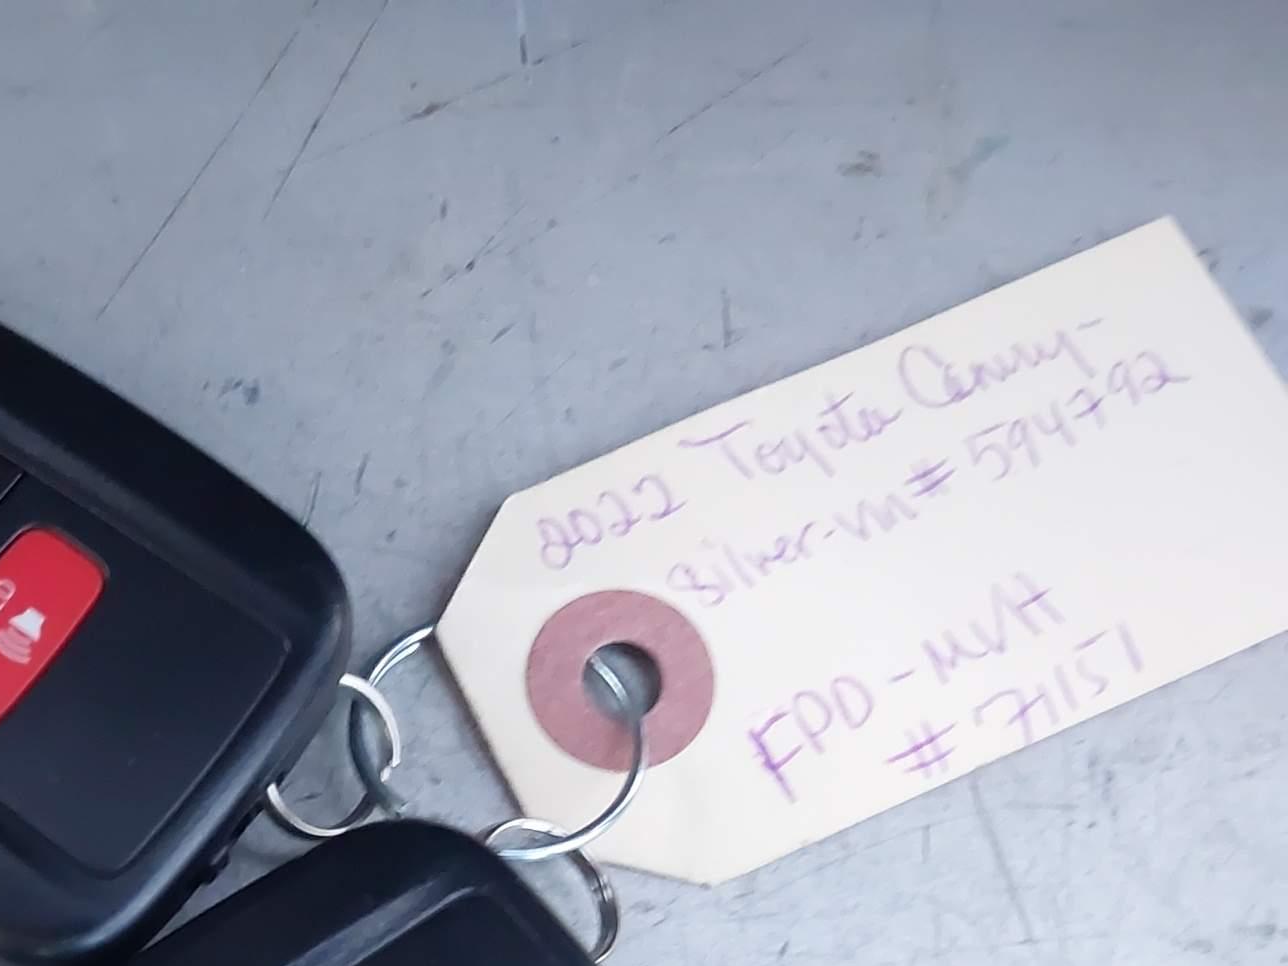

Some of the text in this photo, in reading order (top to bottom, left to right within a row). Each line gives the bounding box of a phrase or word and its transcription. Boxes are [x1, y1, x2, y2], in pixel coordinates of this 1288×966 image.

[537, 473, 689, 570] 2022
[678, 391, 902, 478] Toyota
[963, 350, 1192, 481] 594792
